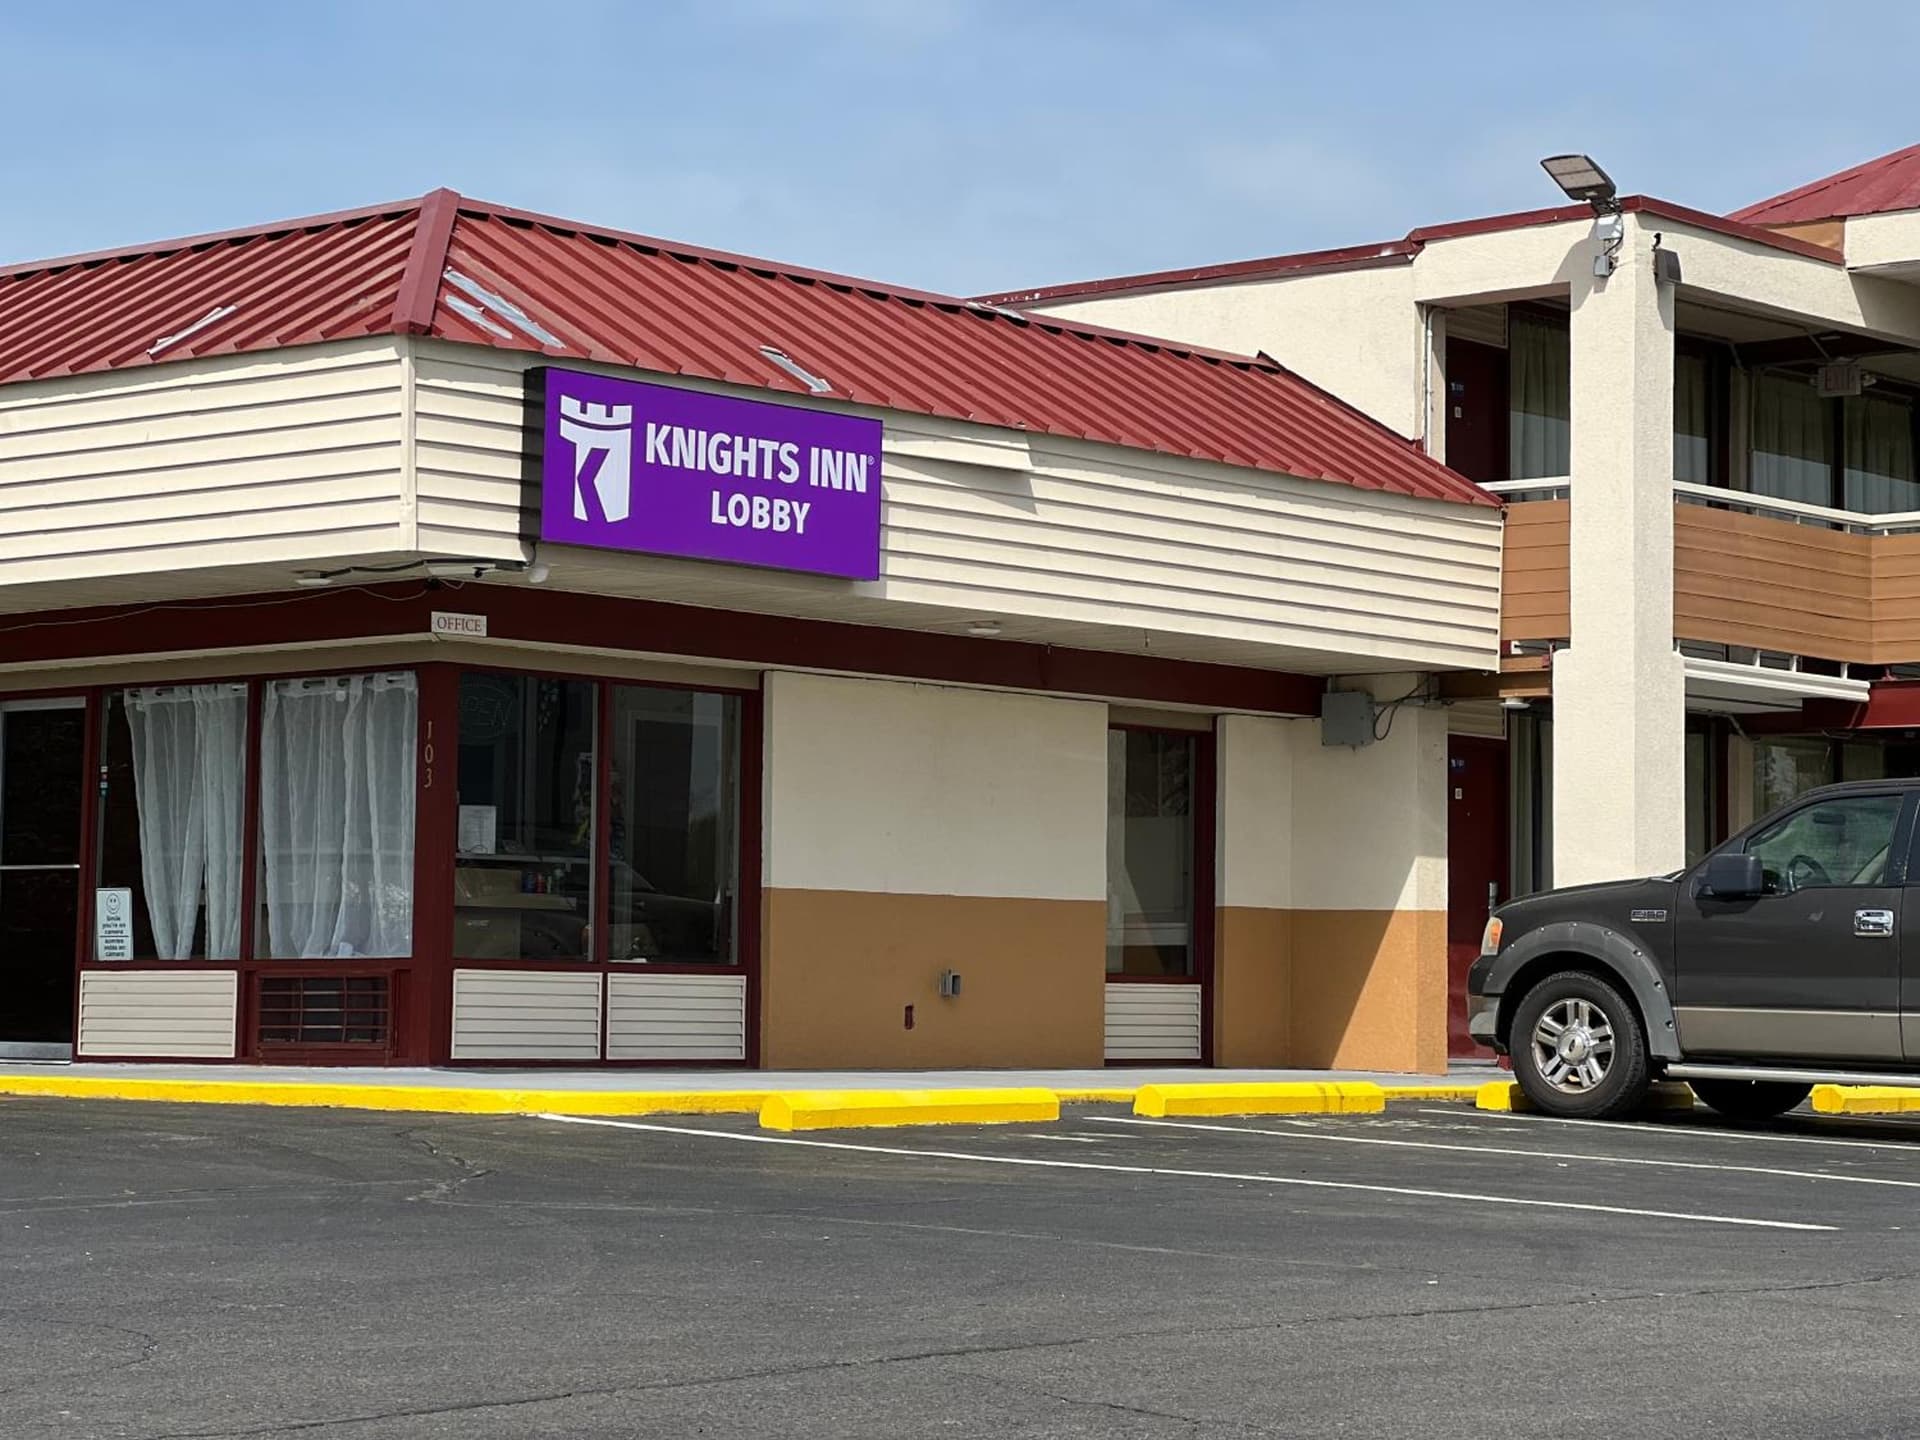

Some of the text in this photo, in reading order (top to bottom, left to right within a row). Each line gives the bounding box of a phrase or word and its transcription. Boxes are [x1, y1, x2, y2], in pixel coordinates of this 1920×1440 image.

[645, 422, 800, 484] KNIGHTS
[711, 491, 811, 534] LOBBY
[437, 616, 482, 632] OFFICE
[424, 720, 434, 788] 103
